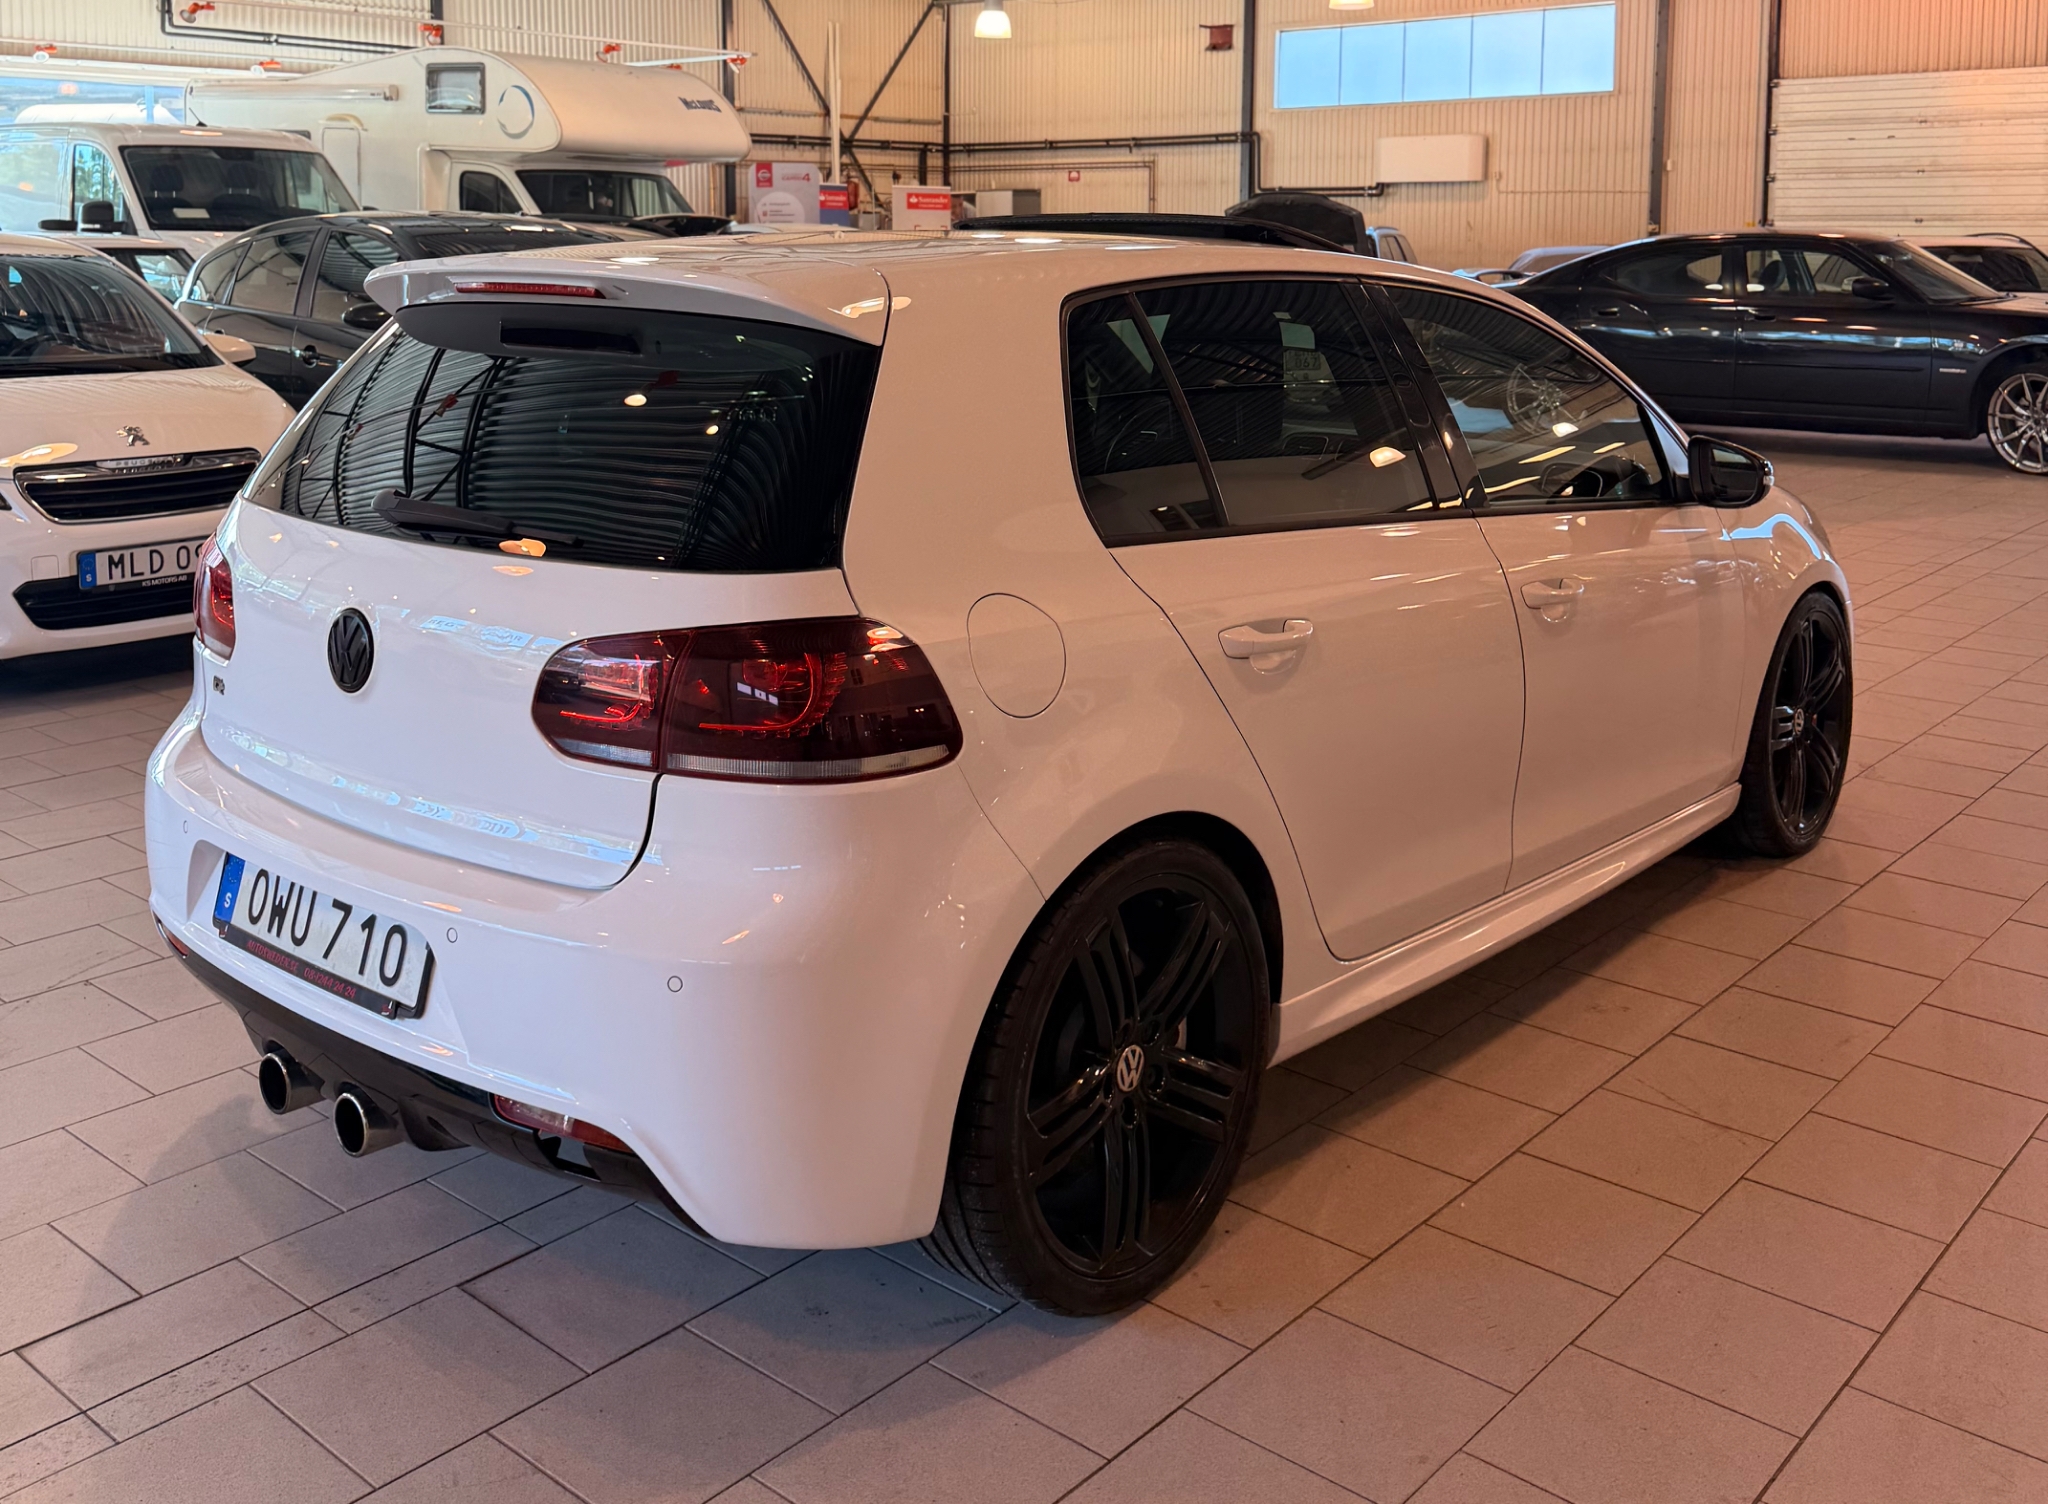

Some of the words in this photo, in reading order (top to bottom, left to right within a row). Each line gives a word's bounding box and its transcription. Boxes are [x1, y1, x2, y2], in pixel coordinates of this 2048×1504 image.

[108, 549, 164, 580] MLD
[151, 576, 178, 585] MOTORS
[224, 892, 232, 908] S
[248, 868, 317, 947] OWU
[322, 898, 408, 987] 710
[1117, 1045, 1145, 1092] VW
